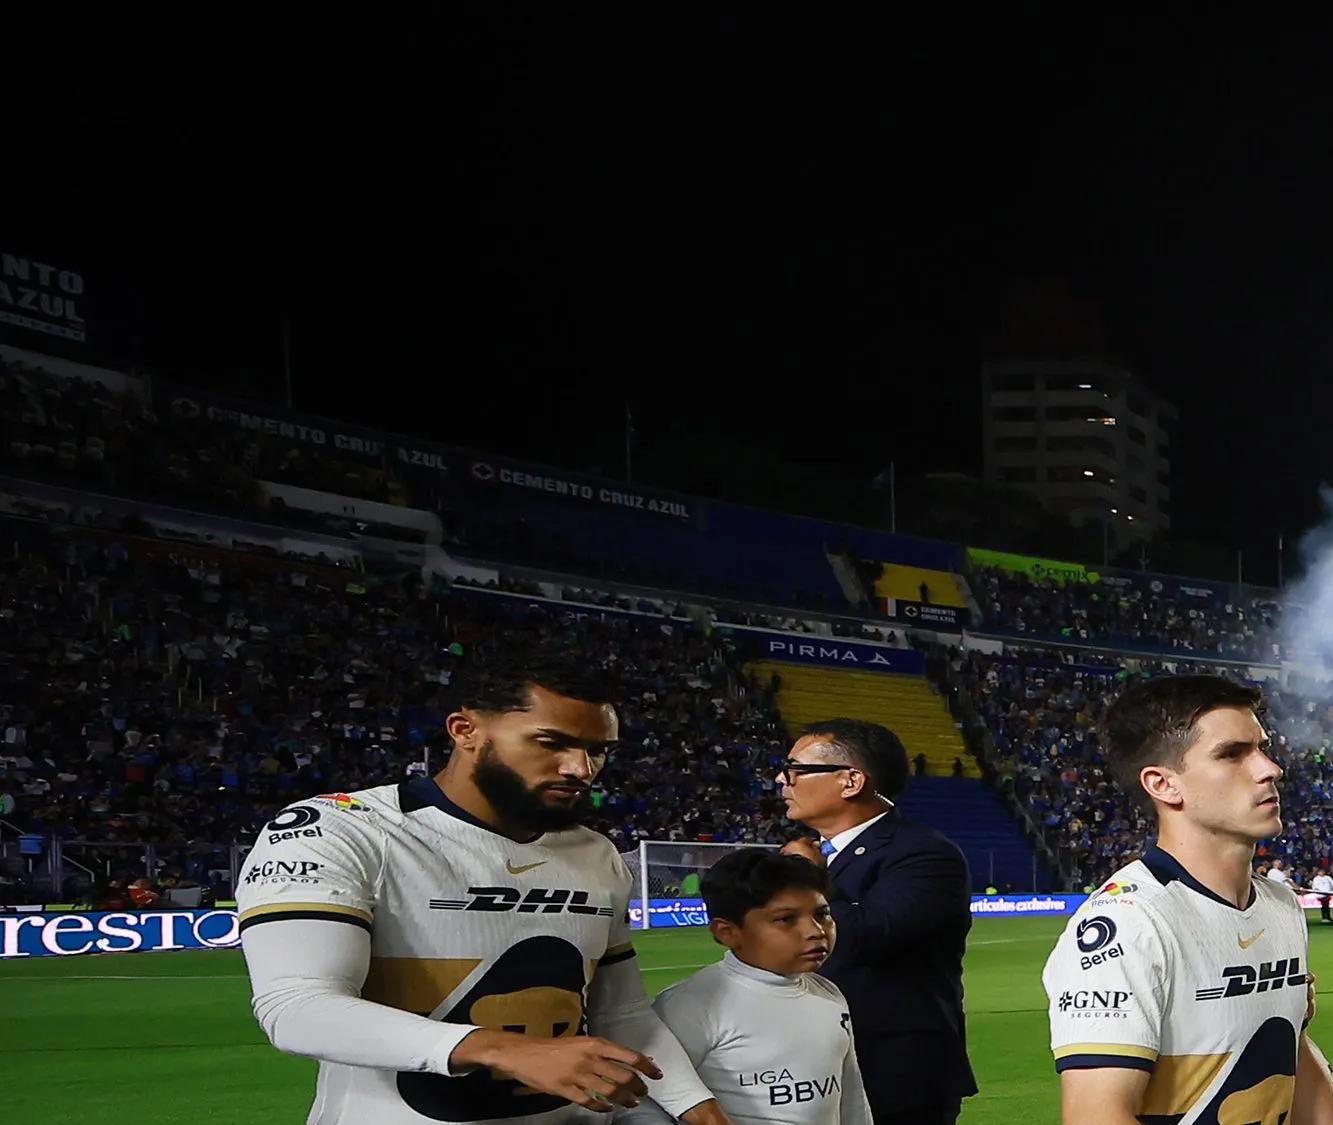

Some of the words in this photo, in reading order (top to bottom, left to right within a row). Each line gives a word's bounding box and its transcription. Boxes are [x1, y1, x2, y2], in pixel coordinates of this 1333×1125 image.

[1, 251, 85, 296] NTO
[333, 433, 386, 455] CRU
[396, 447, 450, 472] AZUL
[499, 467, 594, 500] CEMENTO
[599, 487, 645, 509] CRUZ
[647, 498, 691, 519] AZUL
[769, 640, 859, 662] PIRMA
[268, 826, 323, 845] Berel
[261, 860, 319, 878] GNP
[465, 886, 599, 916] DHL
[1080, 943, 1125, 971] Berel
[1222, 957, 1307, 999] DHL
[1074, 990, 1130, 1010] GNP
[1071, 1011, 1129, 1019] SEGUROS
[739, 1068, 795, 1087] LIGA
[769, 1074, 841, 1107] BBVA
